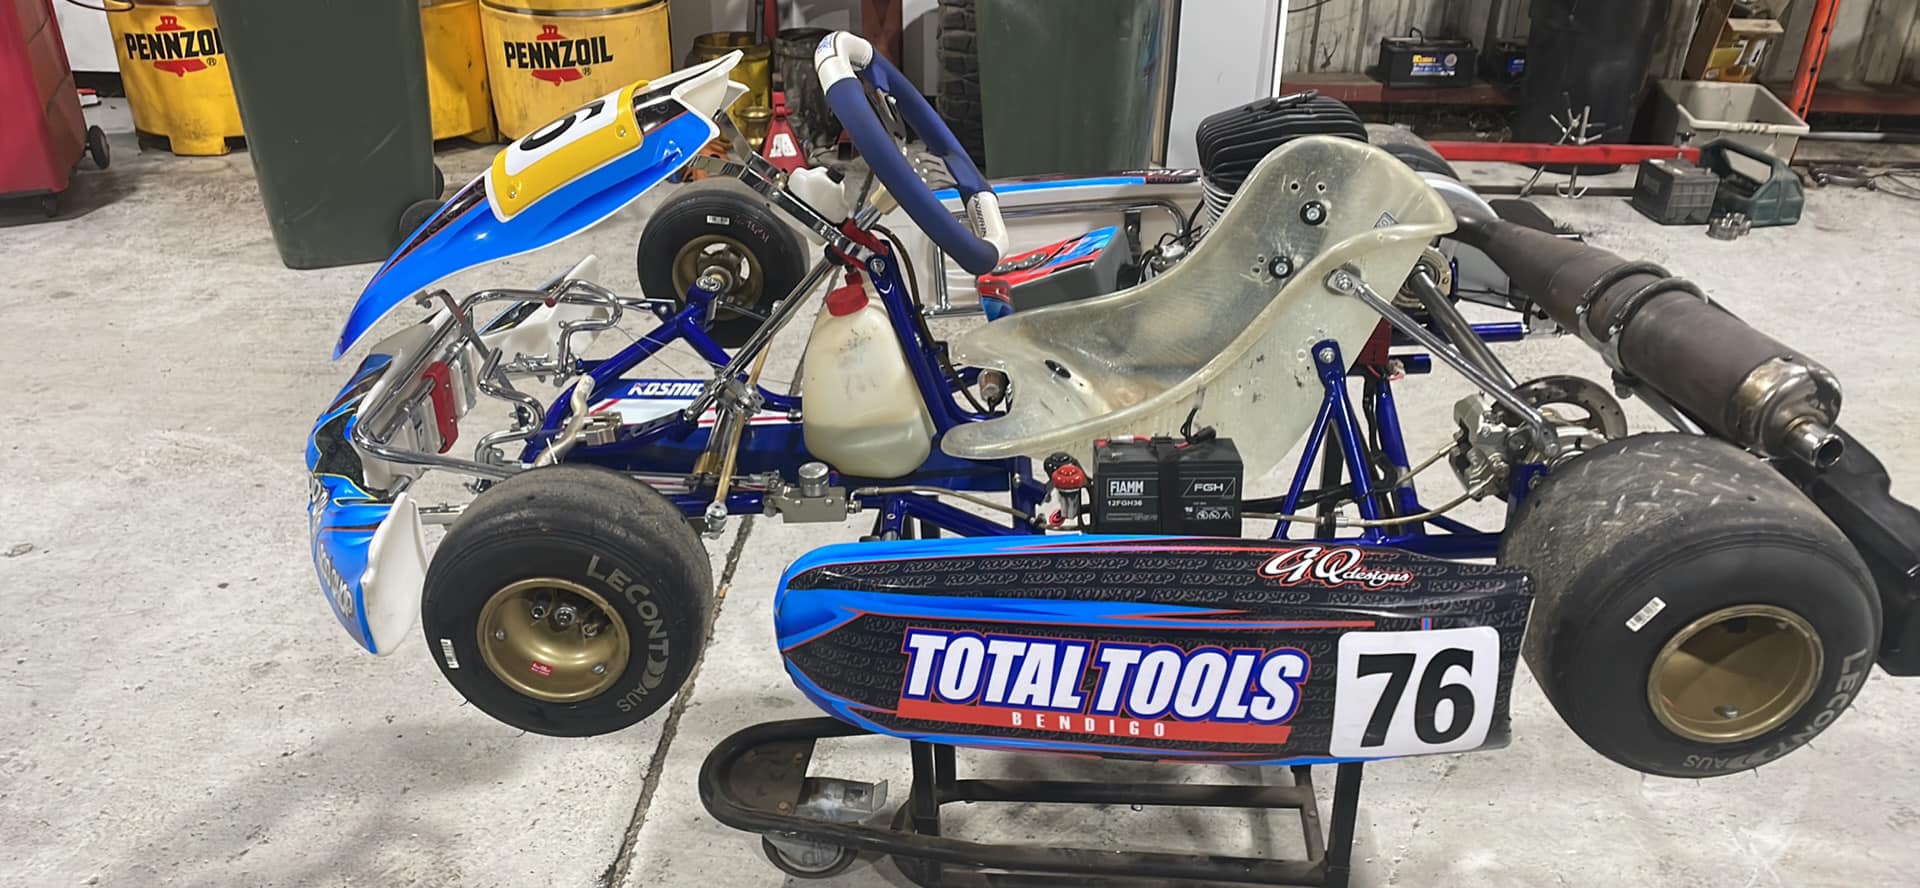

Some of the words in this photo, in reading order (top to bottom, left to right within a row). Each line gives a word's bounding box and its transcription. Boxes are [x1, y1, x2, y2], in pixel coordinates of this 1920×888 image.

[125, 28, 224, 60] PENNZOI
[503, 36, 614, 69] PENNZOIL
[628, 382, 704, 396] KOSMIC
[1110, 480, 1144, 494] FIAMM
[1193, 483, 1224, 493] FGH
[1342, 567, 1411, 587] designs
[586, 554, 669, 657] LECONT
[906, 632, 1087, 711] TOTAL
[1094, 646, 1305, 722] TOOLS
[616, 686, 648, 713] AUS
[1356, 647, 1476, 748] 76
[1011, 711, 1166, 737] BENDIGO
[1683, 754, 1729, 769] AUS
